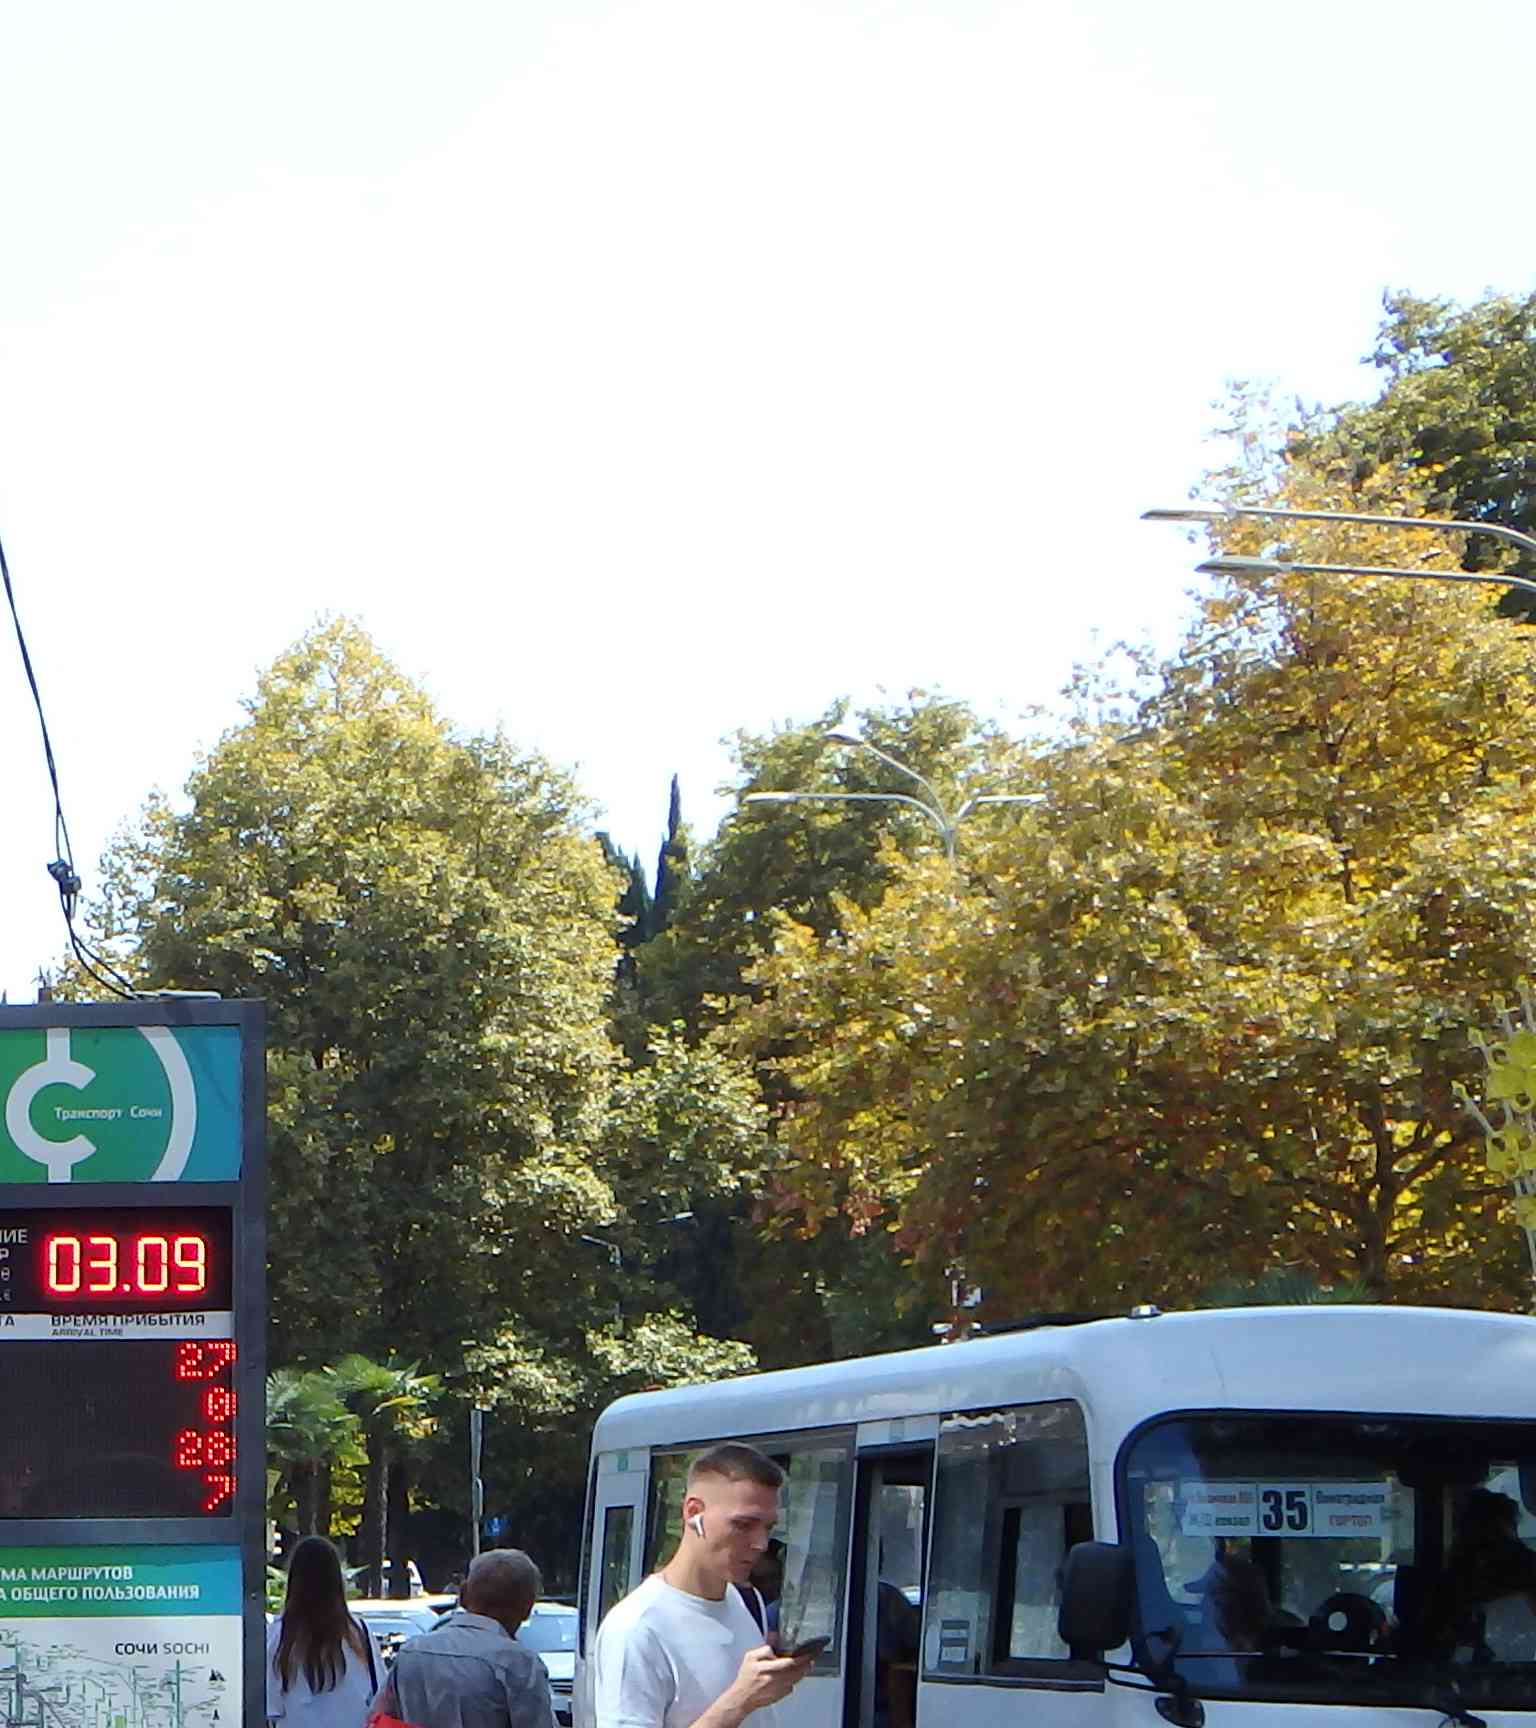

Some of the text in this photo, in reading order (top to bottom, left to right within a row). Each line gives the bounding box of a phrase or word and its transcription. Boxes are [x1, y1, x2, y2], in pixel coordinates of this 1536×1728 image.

[47, 1236, 207, 1292] 03.09
[51, 1313, 206, 1328] ВРЕМЯ ПРИБЫТИЯ
[179, 1343, 233, 1378] 27
[179, 1430, 233, 1466] 28
[207, 1475, 232, 1510] 7
[1261, 1489, 1310, 1532] 35
[31, 1566, 133, 1581] МАРШРУТОВ
[11, 1585, 78, 1603] ОБЩЕГО
[82, 1584, 200, 1600] ПОЛЬЗОВАНИЯ
[114, 1642, 210, 1656] СОЧИ SOCHI
